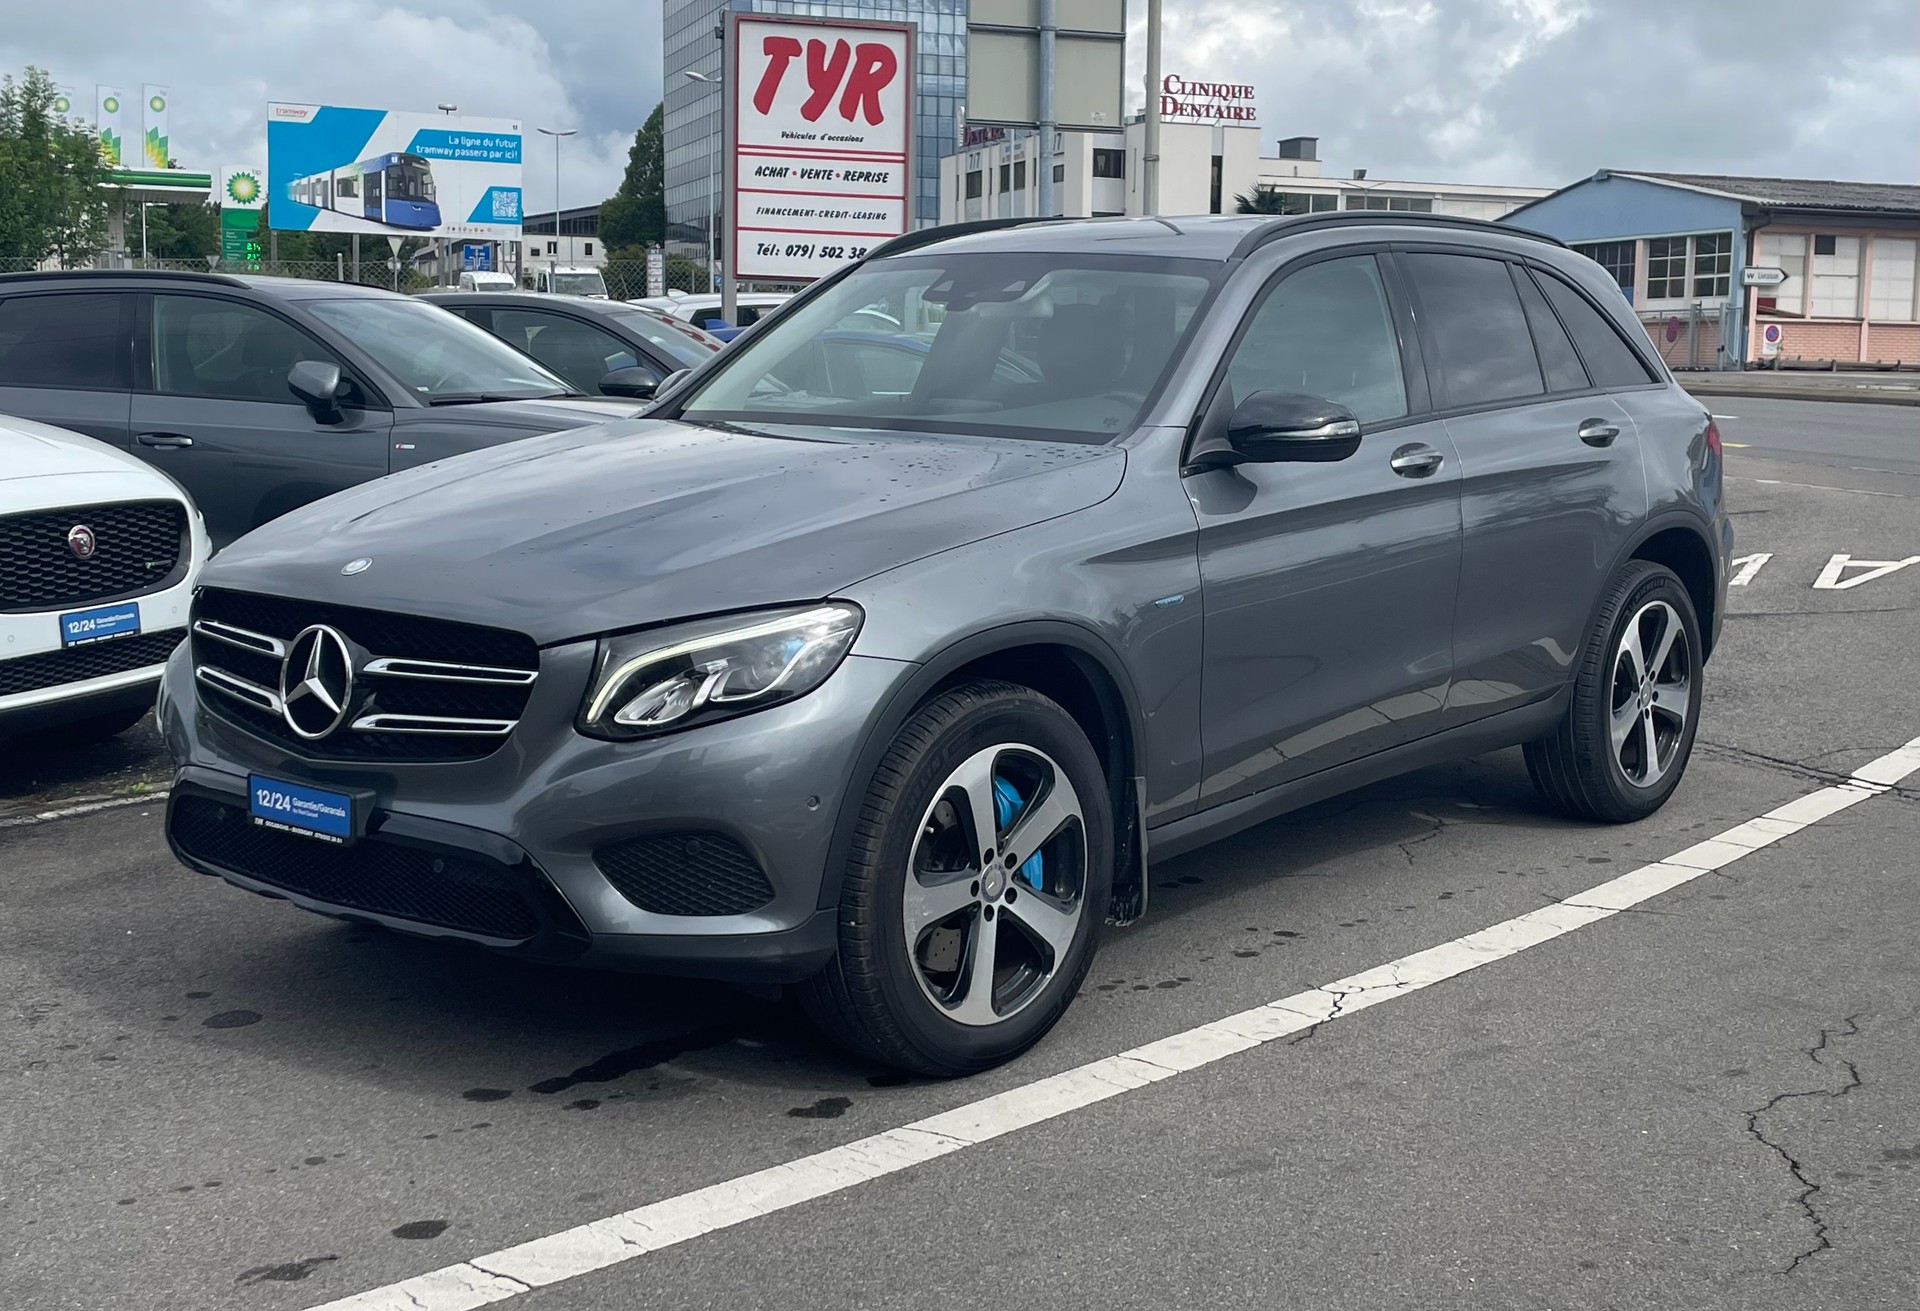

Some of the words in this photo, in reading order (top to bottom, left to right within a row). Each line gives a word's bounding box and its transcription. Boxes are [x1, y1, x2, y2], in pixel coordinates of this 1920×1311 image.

[753, 36, 897, 126] TYR
[449, 135, 459, 145] La
[461, 136, 481, 147] ligne
[483, 138, 493, 147] du
[495, 139, 518, 148] futur
[781, 130, 817, 141] Véhicules
[415, 144, 453, 156] tramway
[455, 148, 488, 158] passera
[489, 150, 503, 159] par
[754, 165, 789, 178] ACHAT
[800, 168, 834, 181] VENTE
[843, 170, 889, 183] REPRISE
[757, 242, 780, 257] Tél:
[819, 246, 843, 259] 502
[68, 618, 96, 634] 12/24
[256, 789, 291, 812] 12/24
